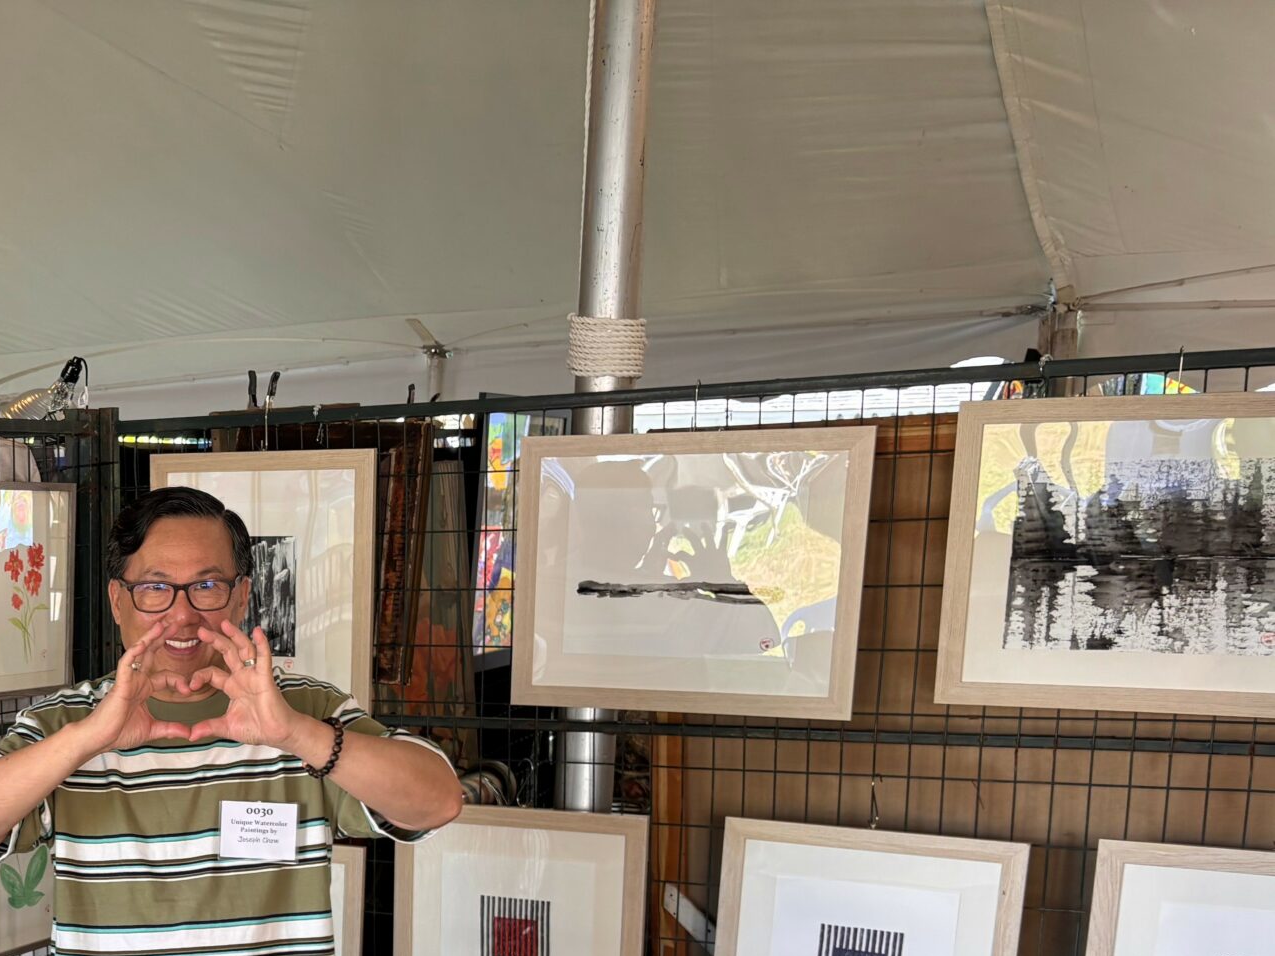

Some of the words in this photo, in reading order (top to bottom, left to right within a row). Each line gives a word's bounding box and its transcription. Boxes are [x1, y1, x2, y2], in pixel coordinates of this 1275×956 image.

[246, 807, 274, 818] 0030
[230, 819, 254, 827] Unique
[254, 819, 288, 827] Watercolor
[240, 827, 269, 835] Paintings
